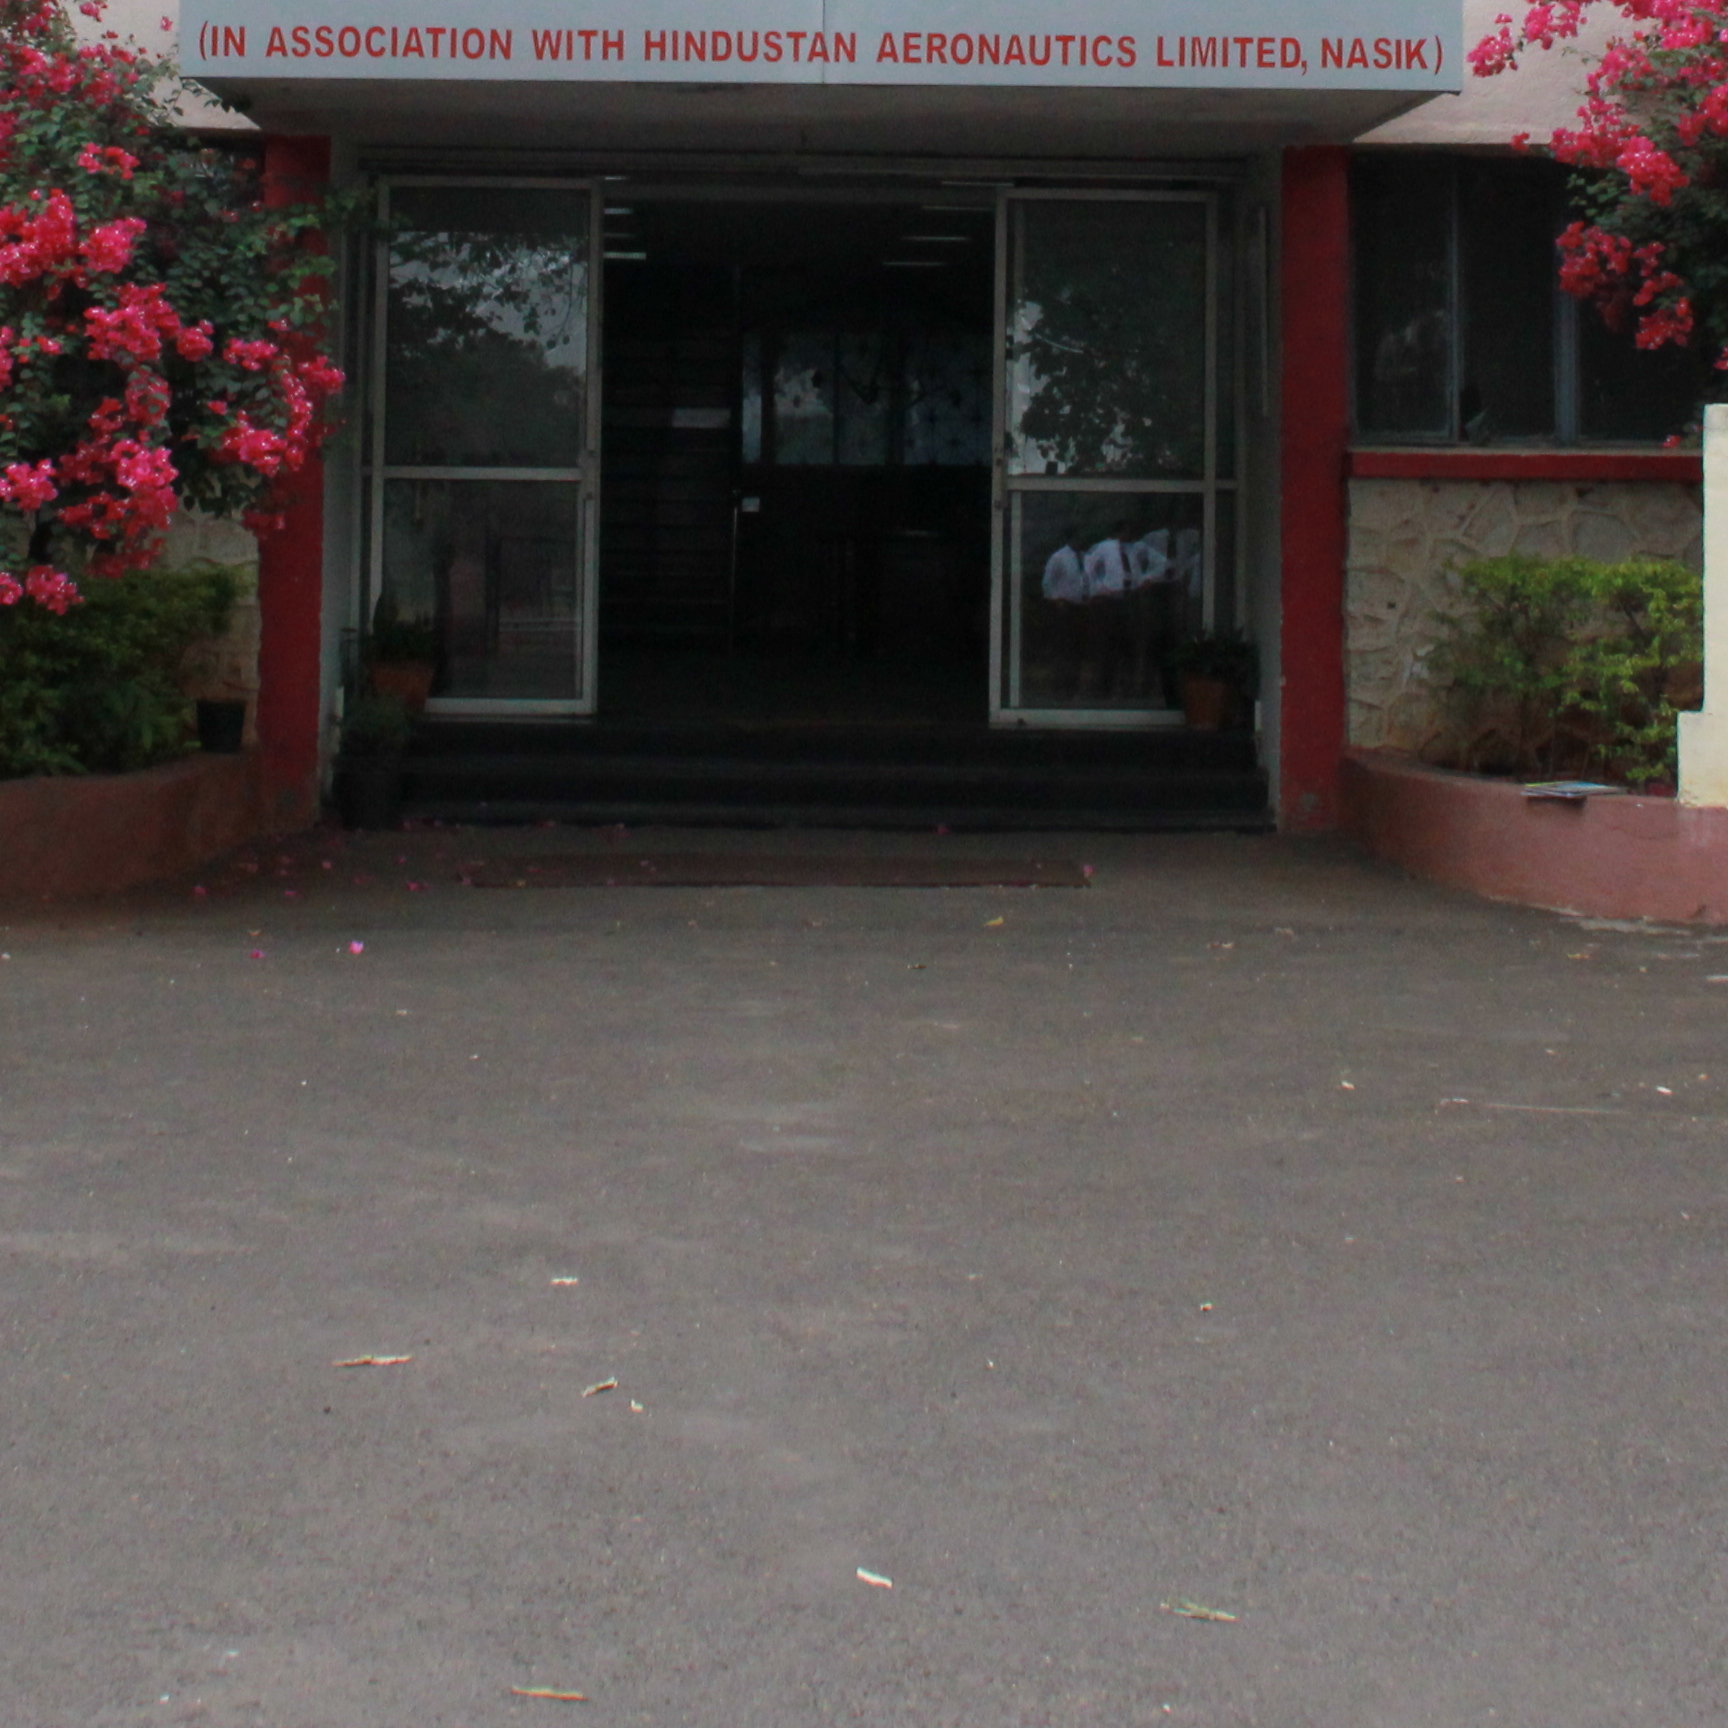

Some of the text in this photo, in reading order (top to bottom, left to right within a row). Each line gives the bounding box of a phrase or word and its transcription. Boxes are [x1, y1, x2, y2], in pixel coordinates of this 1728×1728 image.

[197, 20, 1446, 75] (IN ASSOCIATION WITH HINDUSTAN AERONAUTICS LIMITED, NASIK)
